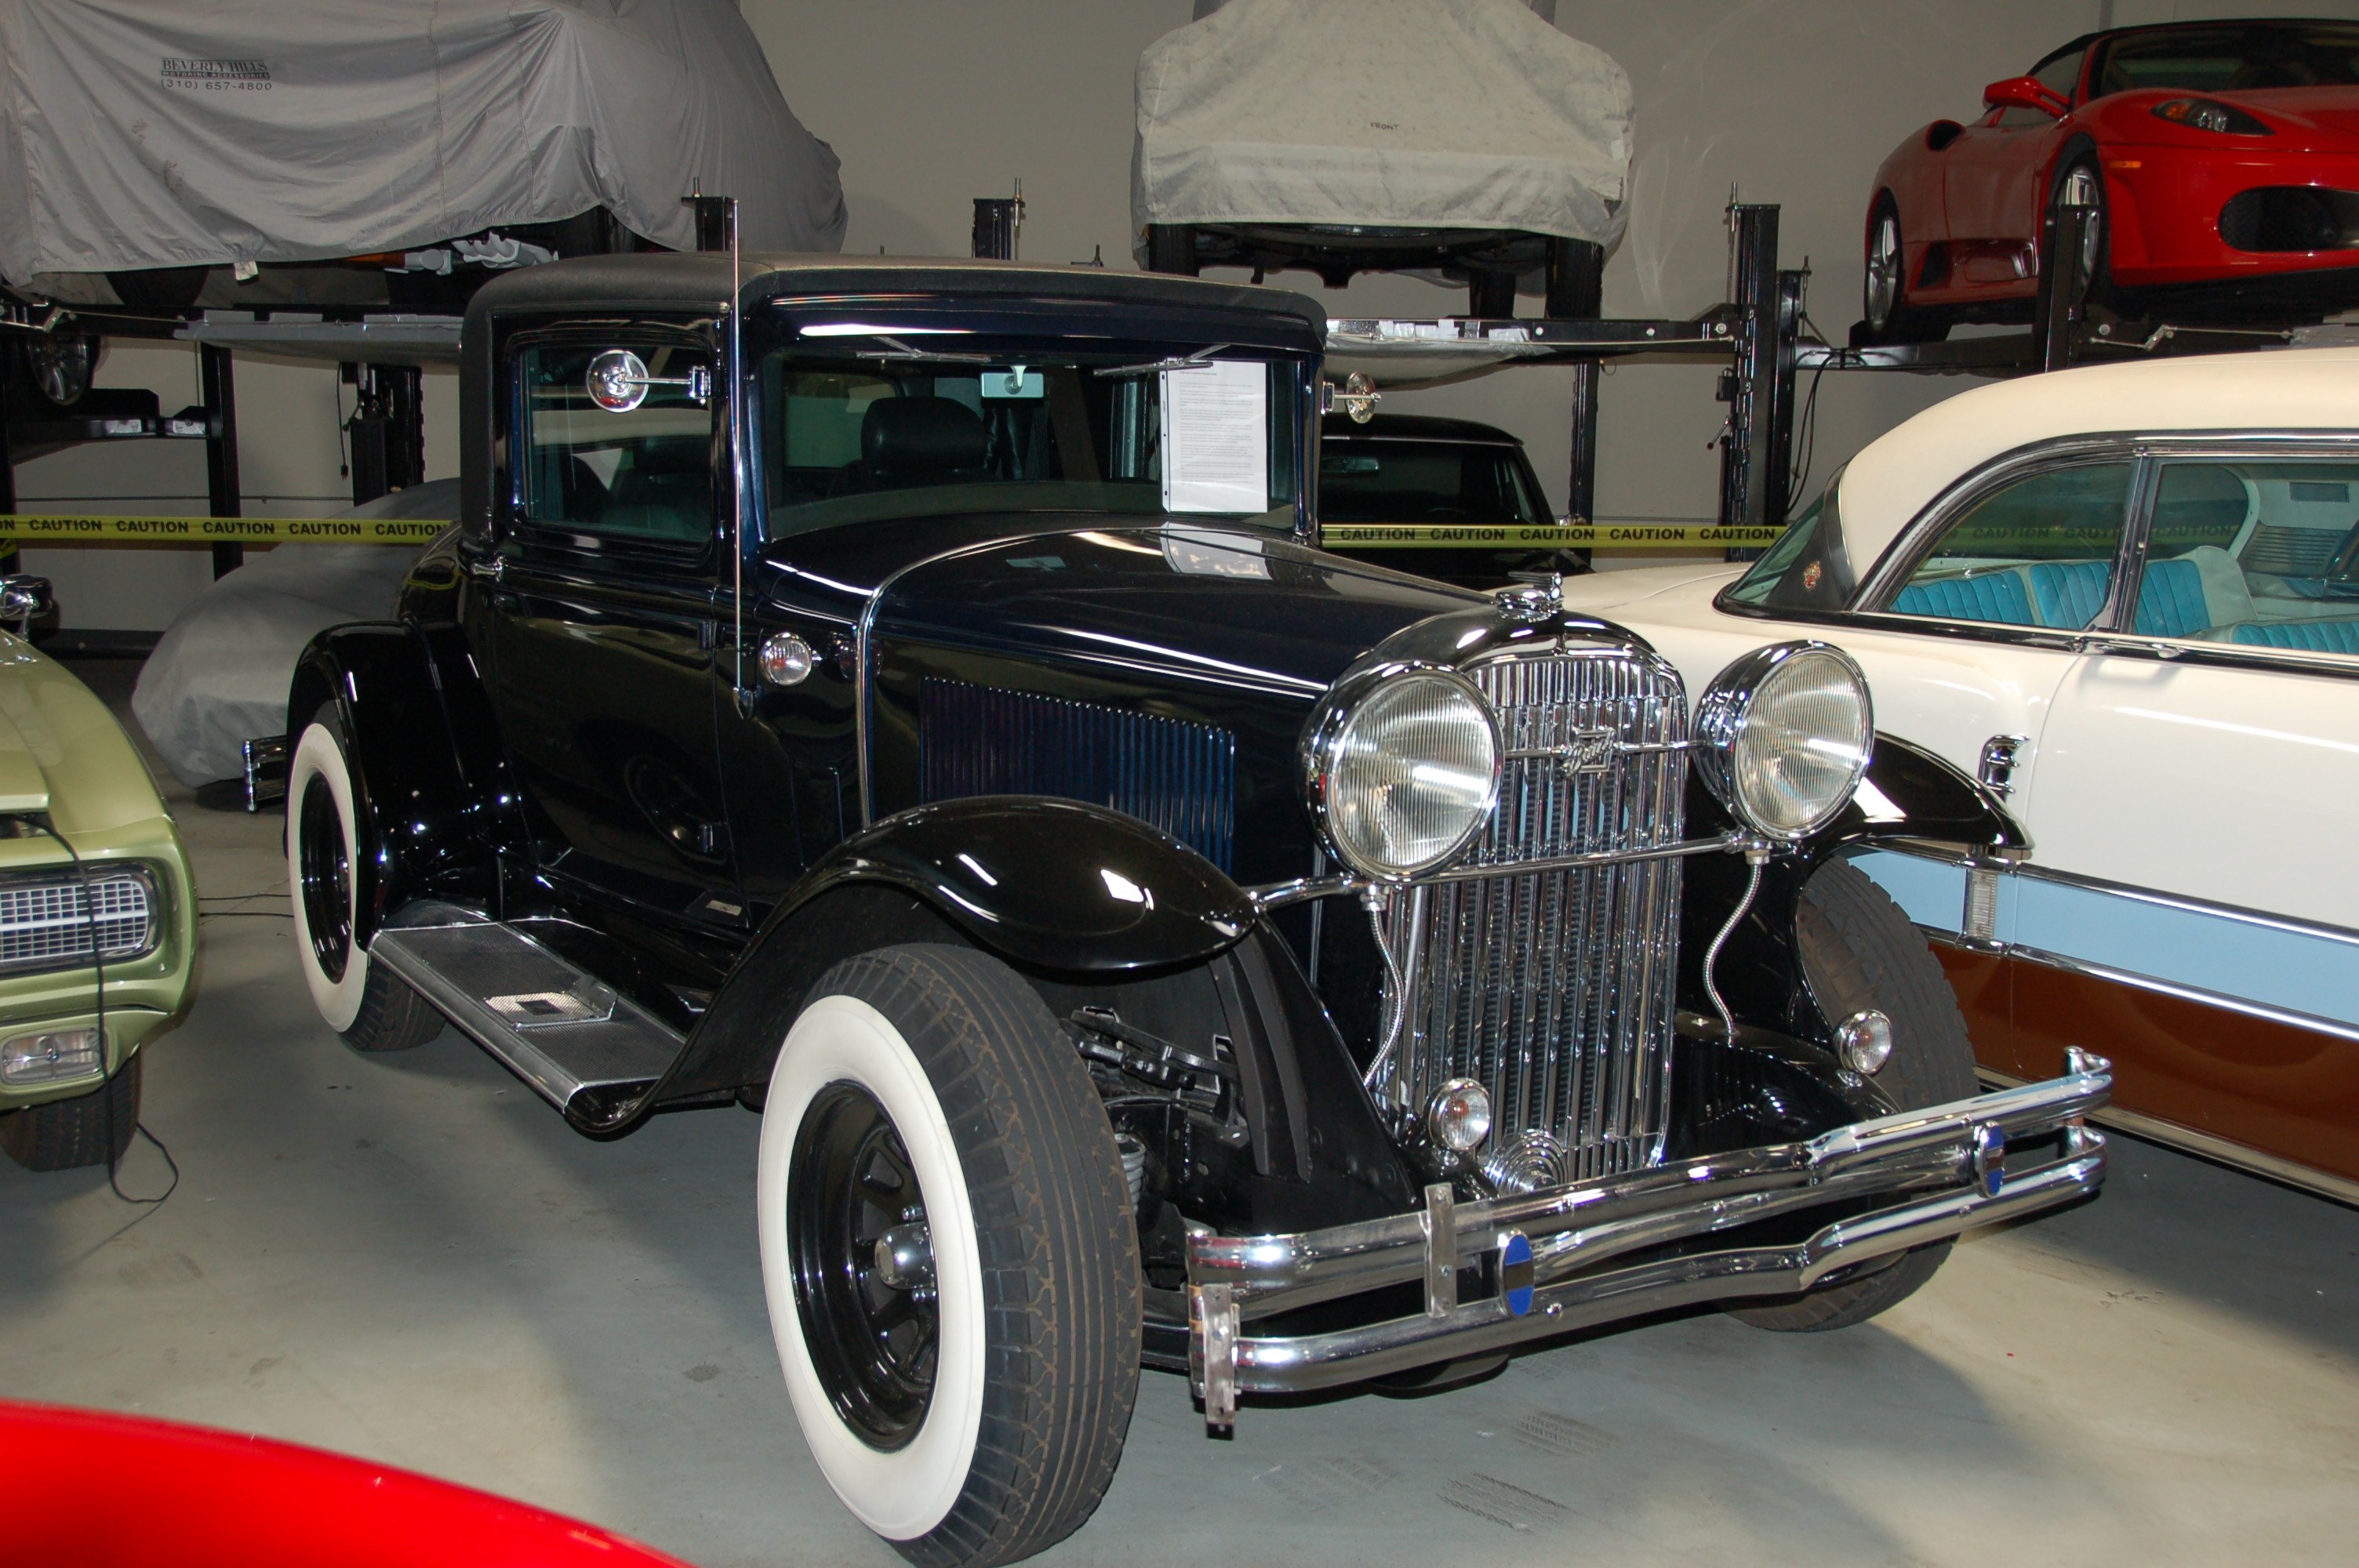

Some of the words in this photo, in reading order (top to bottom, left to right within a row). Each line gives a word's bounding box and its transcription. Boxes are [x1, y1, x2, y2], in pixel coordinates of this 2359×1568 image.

[162, 59, 225, 72] BEVERLY
[229, 61, 268, 72] HILLS
[161, 79, 198, 90] (310)
[205, 82, 272, 91] 657-4800
[29, 520, 103, 531] CAUTION
[116, 521, 189, 532] CAUTION
[202, 521, 275, 534] CAUTION
[289, 523, 362, 535] CAUTION
[1340, 528, 1416, 540] CAUTION
[1430, 528, 1505, 540] CAUTION
[1520, 528, 1595, 540] CAUTION
[1609, 528, 1685, 539] CAUTION
[1699, 528, 1776, 539] CAUTION
